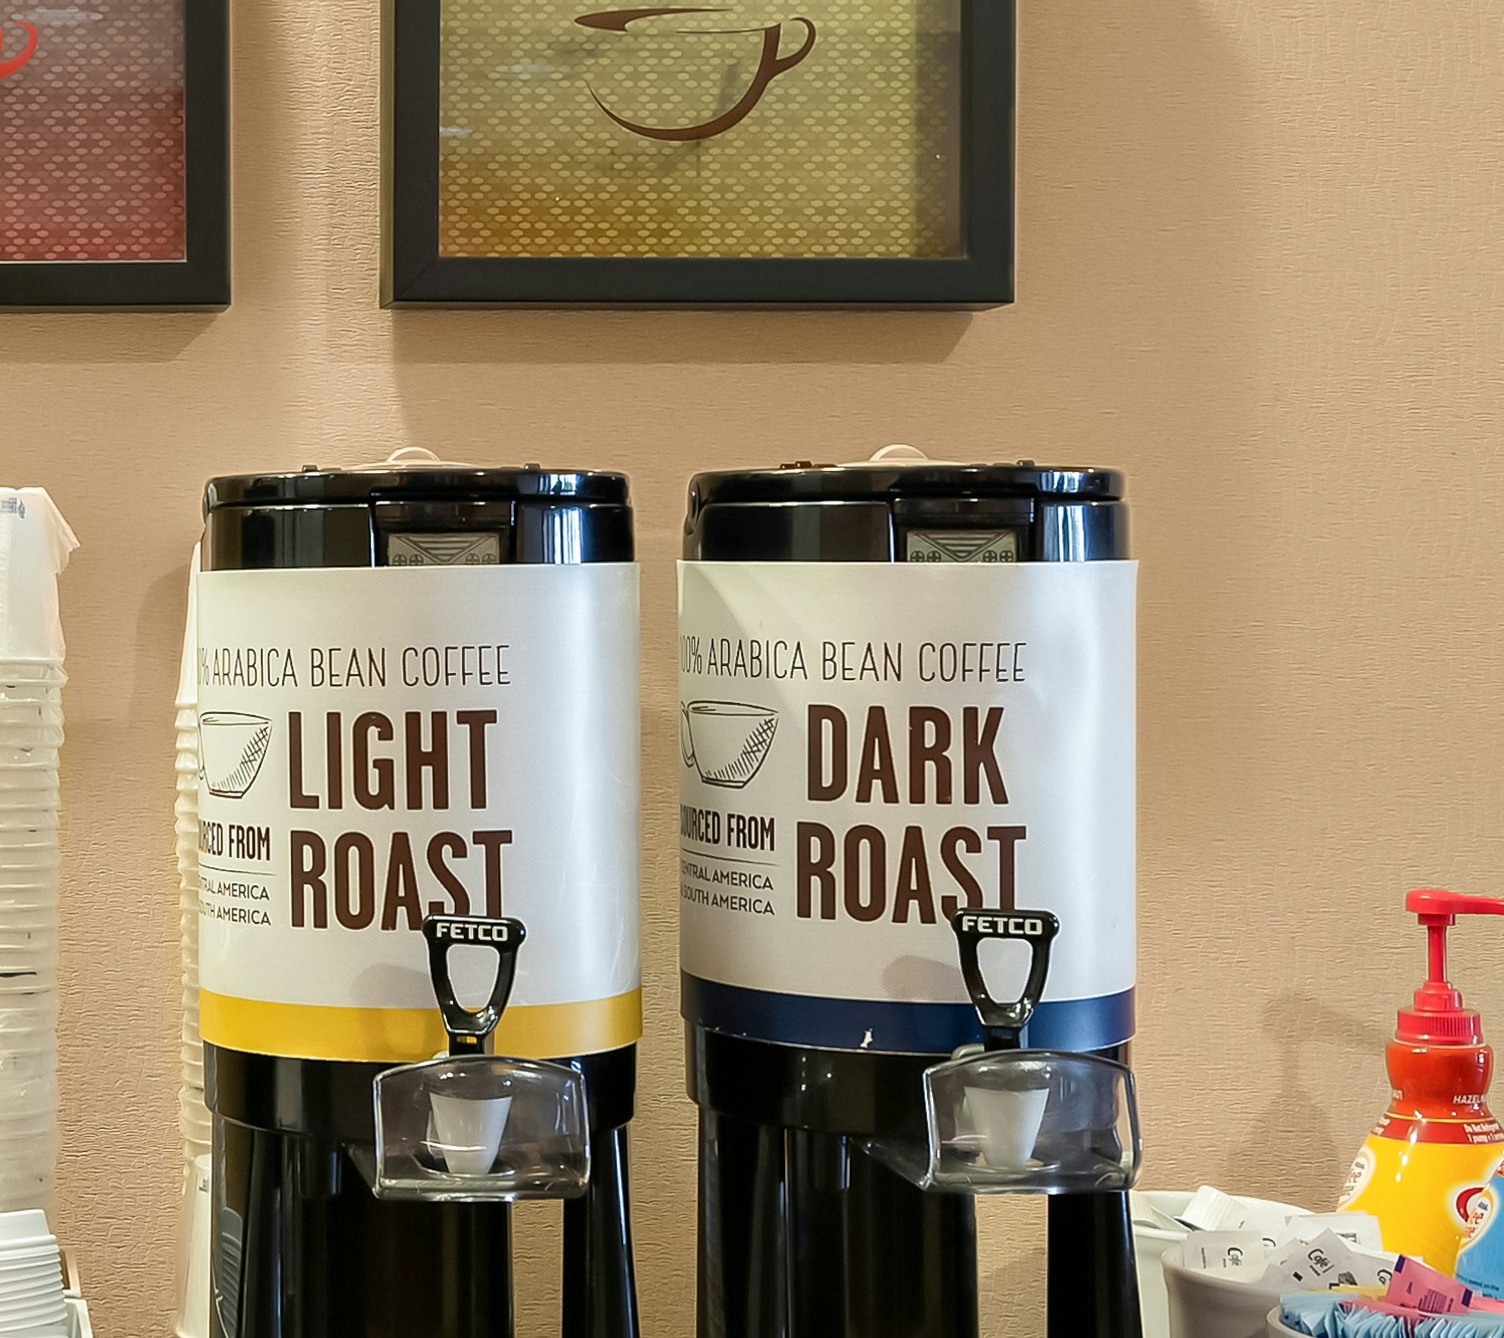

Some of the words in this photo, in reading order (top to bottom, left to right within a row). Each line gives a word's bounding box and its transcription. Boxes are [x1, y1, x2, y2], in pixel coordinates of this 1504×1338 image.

[212, 647, 298, 688] ARABICA
[310, 647, 387, 688] BEAN
[402, 645, 512, 687] COFFEE
[707, 637, 808, 681] ARABICA
[821, 642, 902, 682] BEAN
[919, 642, 1028, 682] COFFEE
[288, 708, 498, 811] LIGHT
[807, 704, 1010, 805] DARK
[228, 824, 271, 861] FROM
[726, 813, 775, 852] FROM
[216, 882, 271, 901] AMERICA
[290, 829, 513, 932] ROAST
[711, 869, 774, 891] AMERICA
[796, 820, 1027, 925] ROAST
[216, 906, 272, 926] AMERICA
[710, 893, 775, 915] AMERICA
[435, 923, 509, 942] FETCO
[961, 916, 1043, 936] FETCO
